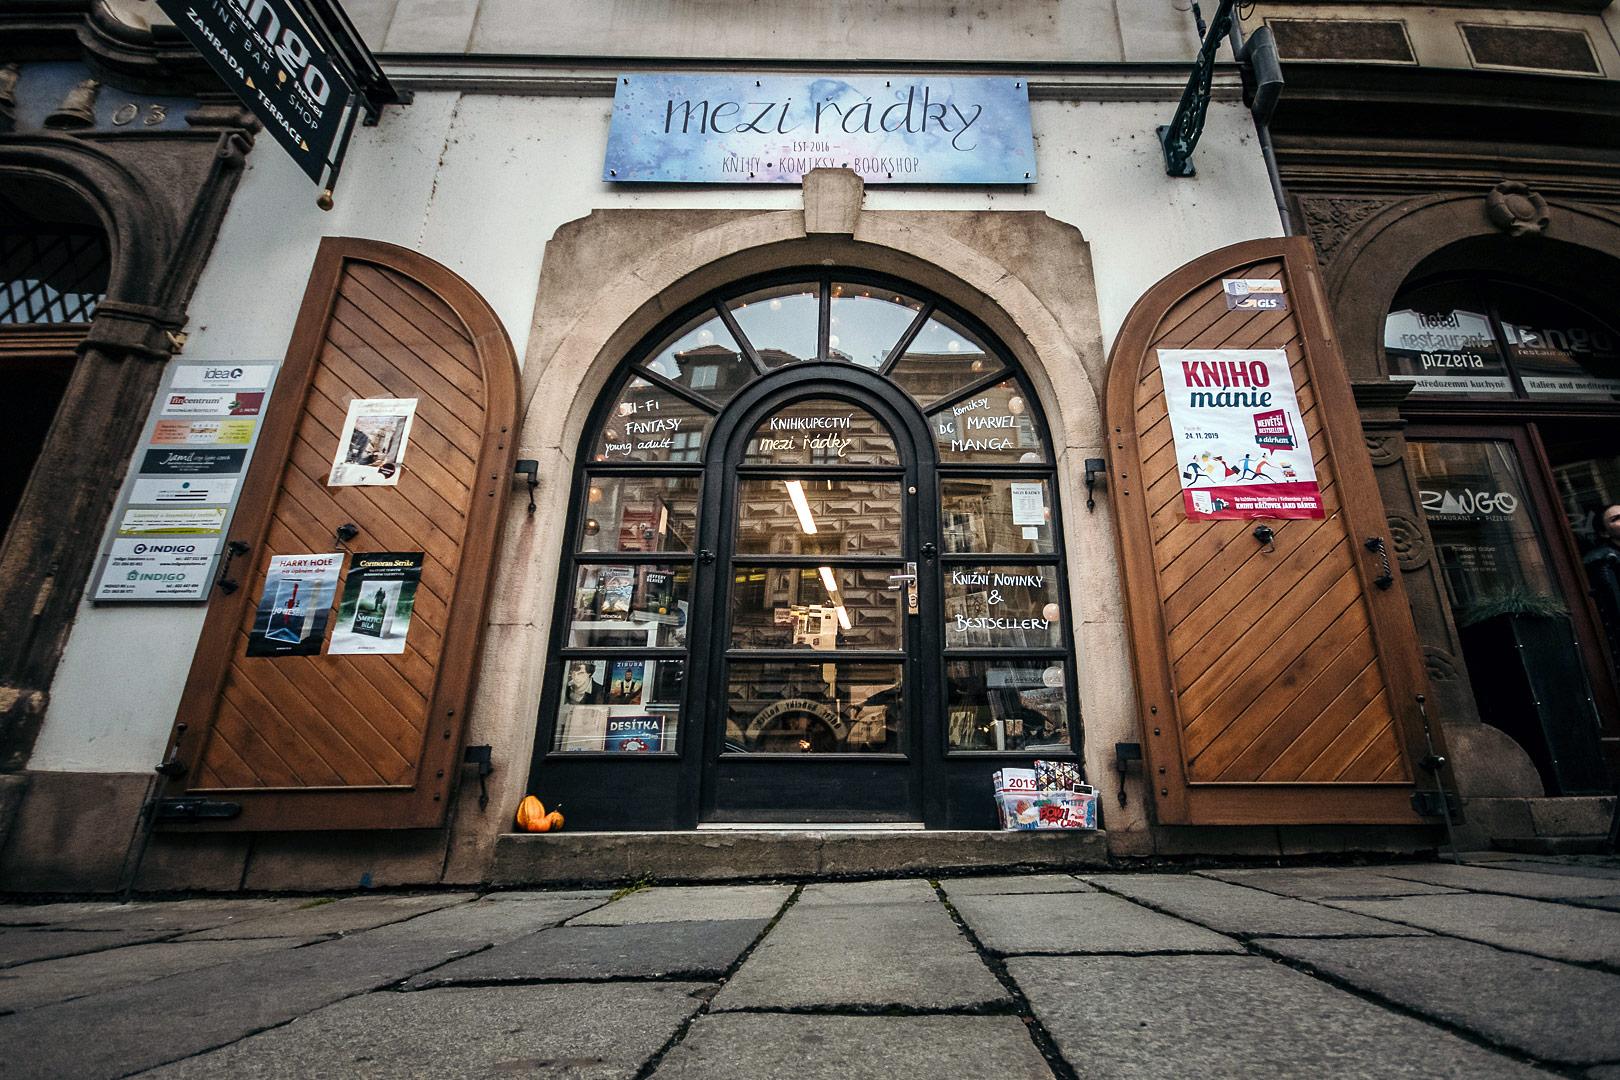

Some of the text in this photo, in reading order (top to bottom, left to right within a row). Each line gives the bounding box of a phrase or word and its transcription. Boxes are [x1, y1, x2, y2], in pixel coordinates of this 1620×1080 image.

[238, 0, 331, 106] ngo
[186, 7, 303, 145] ZAHRADA TERRACE
[243, 39, 270, 75] BAR
[288, 94, 319, 131] SHOP
[664, 85, 983, 152] mezi řádky
[722, 157, 760, 173] KNIHY
[853, 157, 920, 173] BOOKSHOP
[1418, 311, 1460, 329] hotel
[1400, 331, 1489, 349] restaurant
[1420, 351, 1485, 369] pizzeria
[204, 367, 230, 379] idea
[1181, 361, 1270, 388] KNIHO
[1189, 384, 1272, 408] mánie
[624, 418, 683, 435] FANTASY
[770, 413, 854, 430] KNIHKUPECTVÍ
[940, 416, 1021, 435] DC MARVEL
[605, 438, 676, 459] young adult
[760, 433, 852, 457] mezi řádky
[951, 438, 1014, 452] MANGA
[279, 558, 334, 567] HARRY HOLE
[359, 559, 414, 567] Cormoran Strike
[952, 570, 1044, 588] KNIŽNÍ NOVINKY
[988, 589, 1004, 605] &
[955, 613, 1049, 632] BESTSELLERY
[610, 718, 659, 731] DESÍTKA
[1008, 778, 1037, 789] 2019
